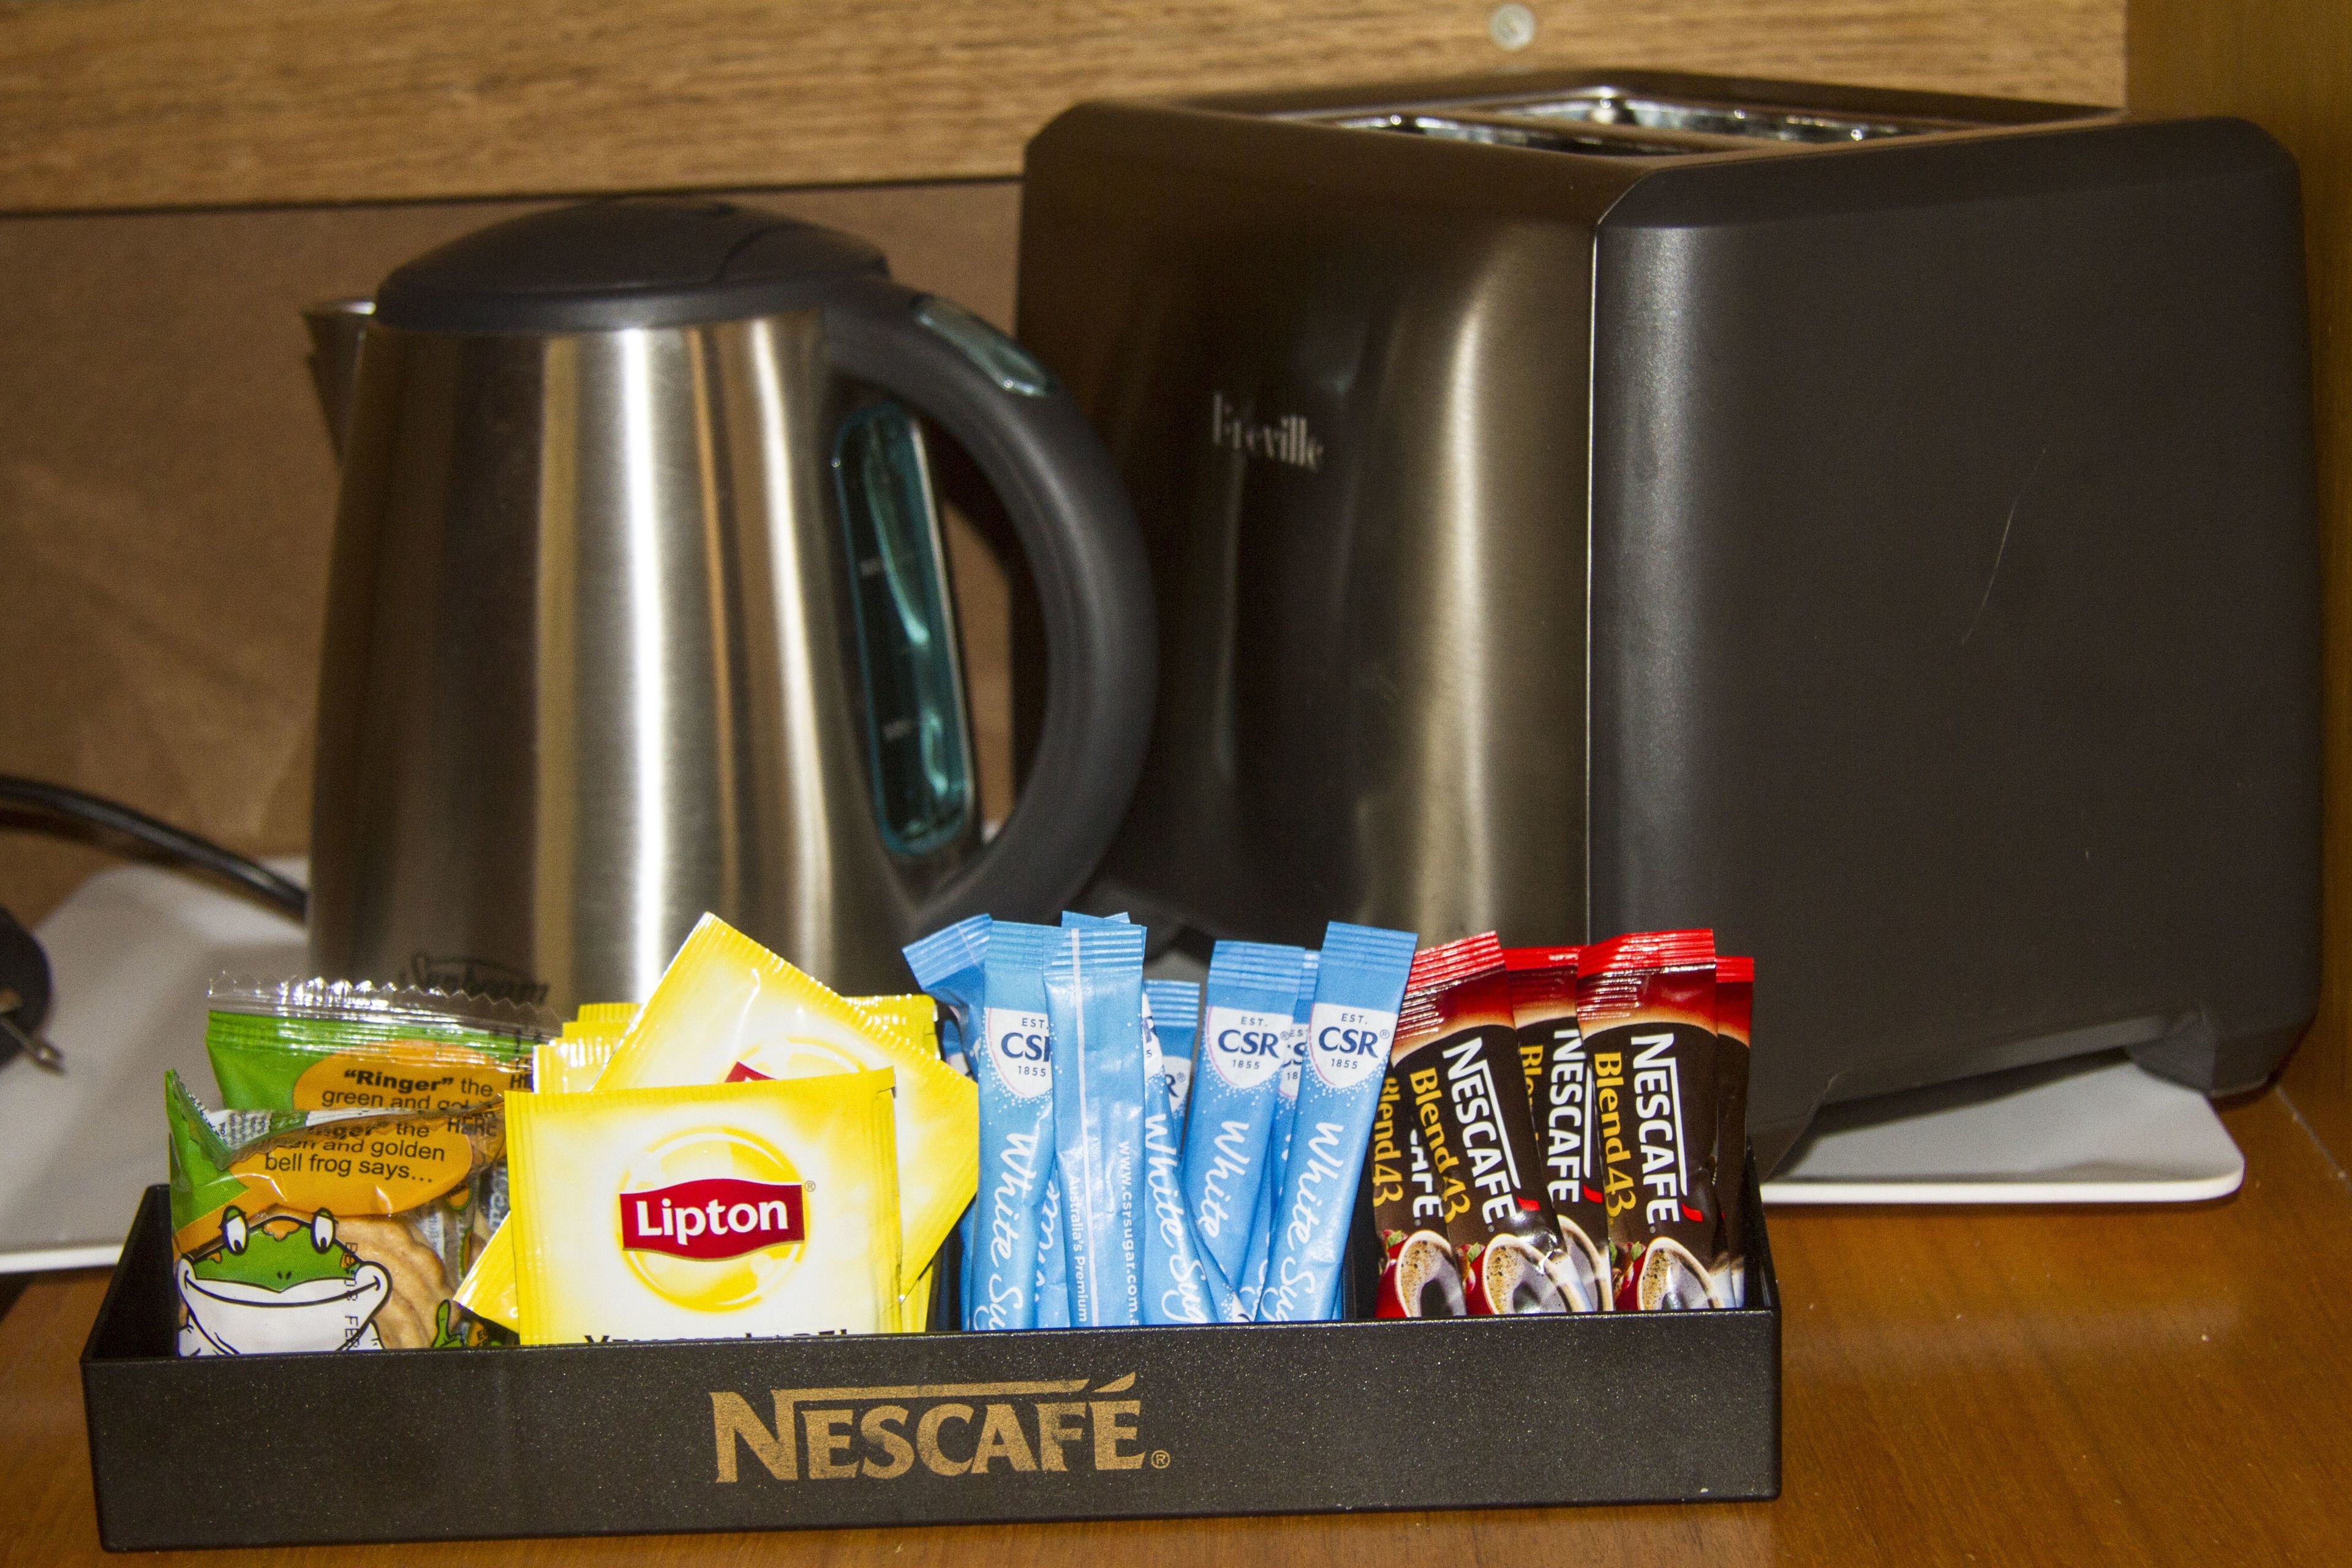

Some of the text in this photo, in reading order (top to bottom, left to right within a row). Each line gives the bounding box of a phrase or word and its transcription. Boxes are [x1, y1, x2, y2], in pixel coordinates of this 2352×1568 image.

[1241, 1017, 1268, 1027] EST.
[1341, 1013, 1368, 1025] EST.
[1218, 1029, 1280, 1059] CSR
[1318, 1026, 1379, 1058] CSR
[1018, 1065, 1047, 1077] 1855
[1232, 1060, 1260, 1069] 1855
[1331, 1058, 1359, 1069] 1855
[322, 1090, 383, 1107] green
[391, 1094, 431, 1109] and
[461, 1078, 493, 1097] the
[396, 1122, 430, 1138] the
[1409, 1067, 1460, 1174] Blend
[1594, 1052, 1637, 1218] Blend 43
[265, 1153, 302, 1172] bell
[309, 1154, 352, 1177] frog
[323, 1139, 364, 1153] and
[371, 1140, 445, 1161] golden
[1145, 1114, 1184, 1248] White
[1197, 1120, 1250, 1238] White
[1287, 1121, 1344, 1251] White
[1373, 1163, 1404, 1207] 43
[990, 1133, 1038, 1268] White
[636, 1198, 789, 1246] Lipton
[1069, 1175, 1088, 1322] Australia's Premium
[707, 1371, 1147, 1483] NESCAFÉ
